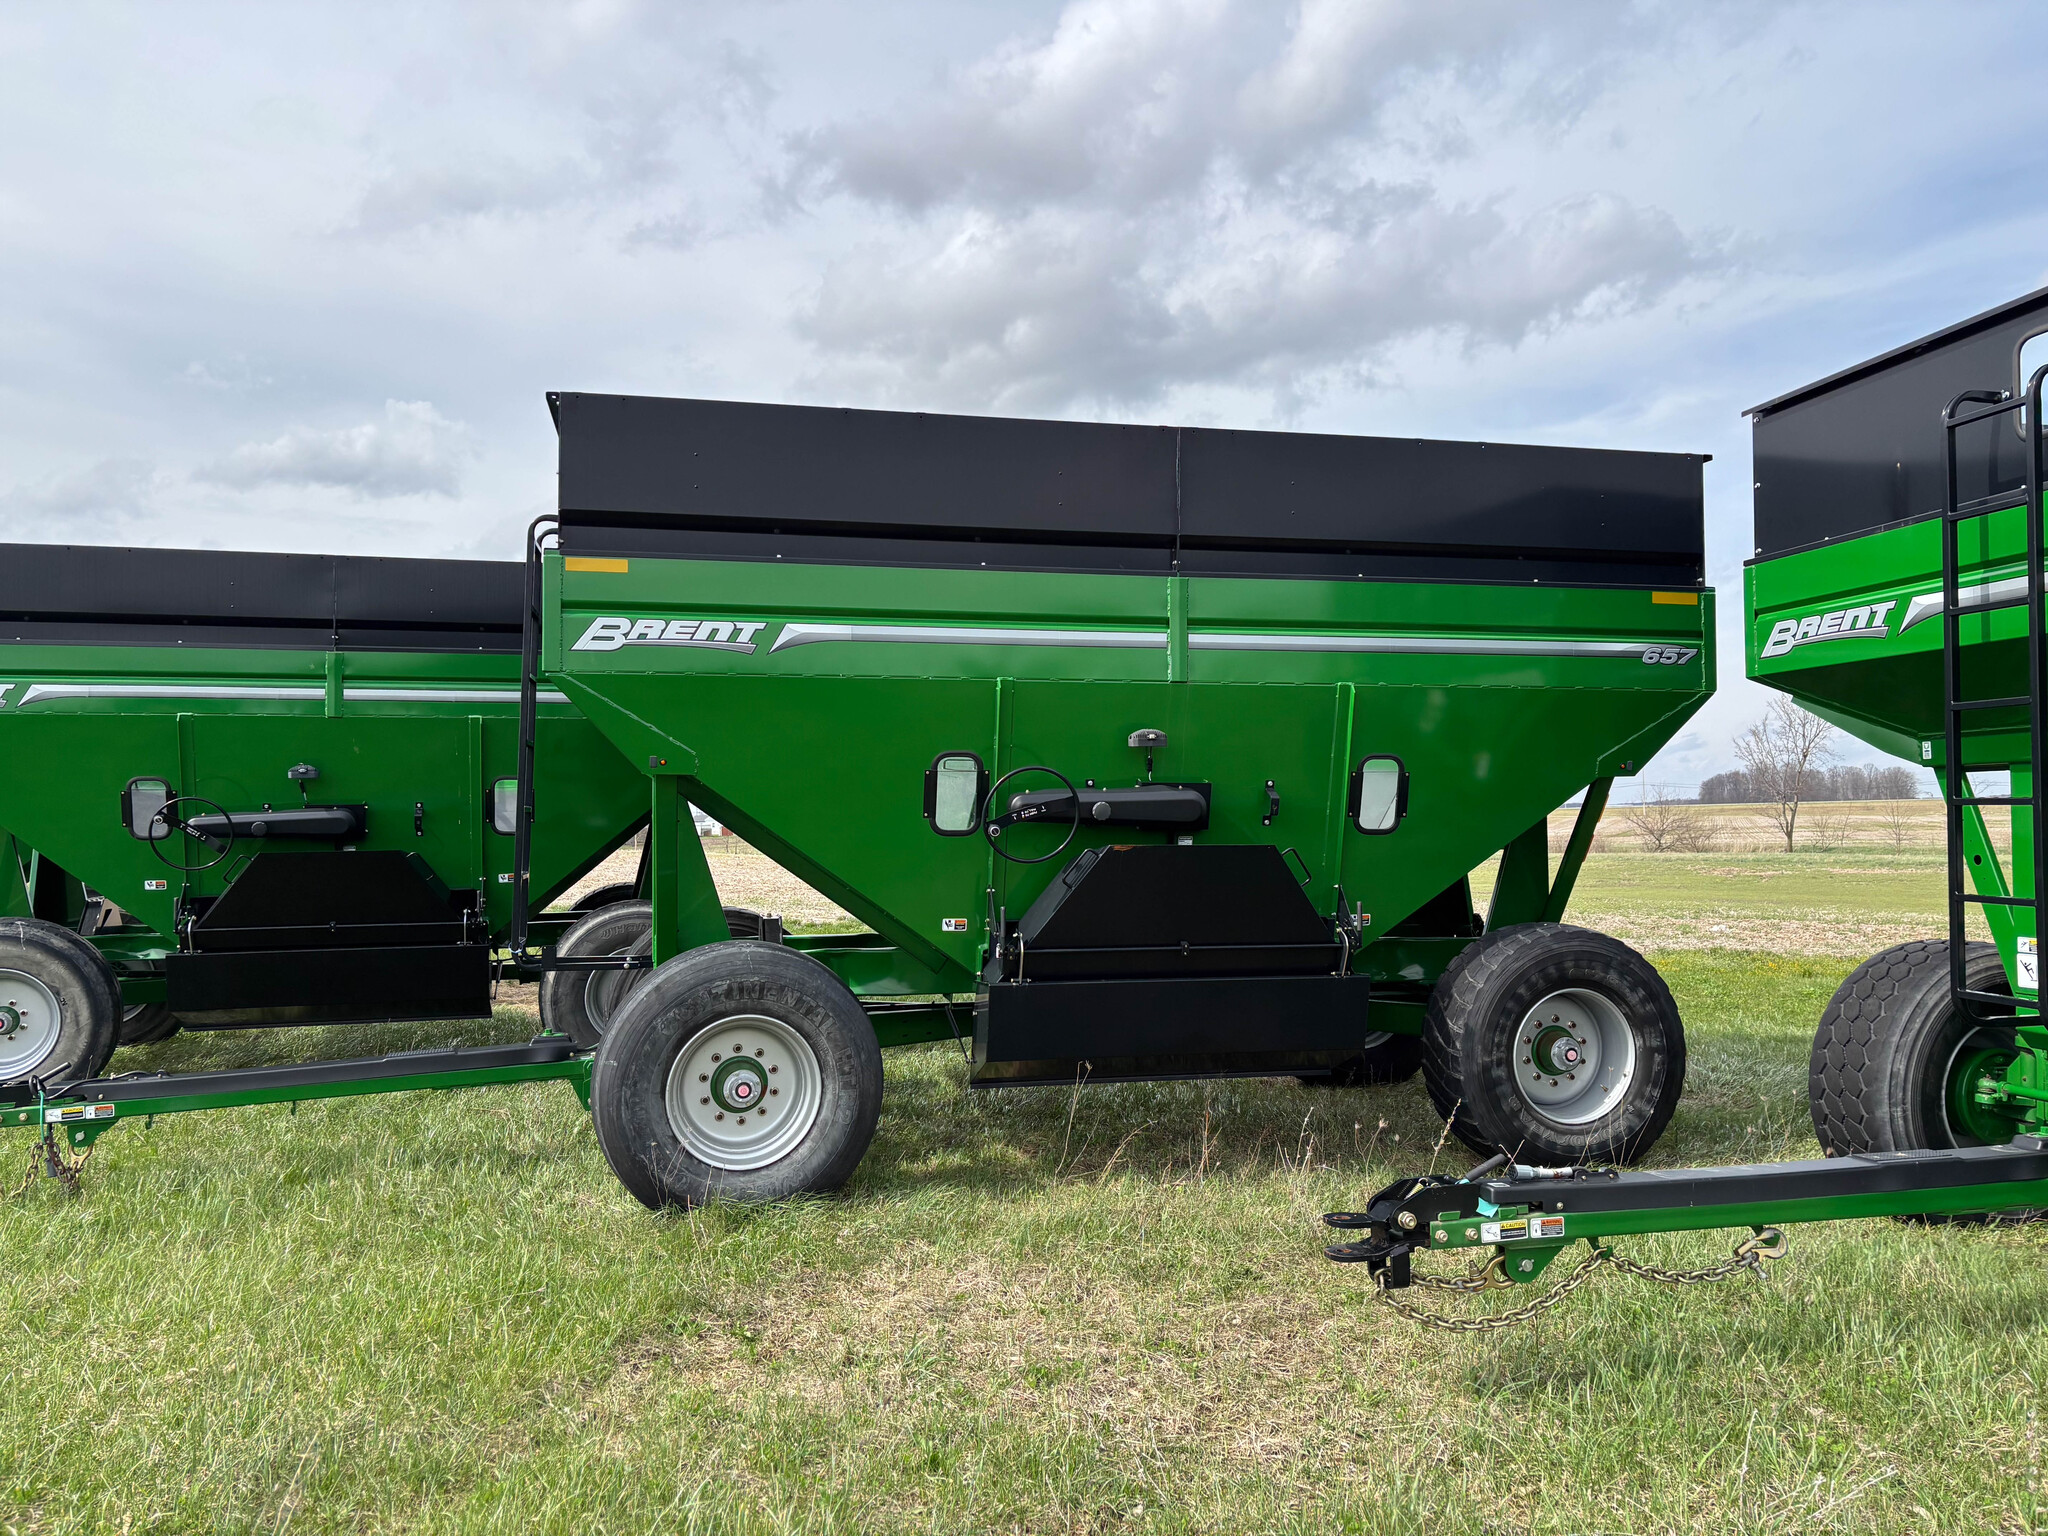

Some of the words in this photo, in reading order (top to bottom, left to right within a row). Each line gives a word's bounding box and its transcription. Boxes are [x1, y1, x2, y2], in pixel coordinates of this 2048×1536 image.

[571, 616, 769, 654] BRENT
[1759, 600, 1898, 659] BRENT
[1642, 647, 1699, 665] 657
